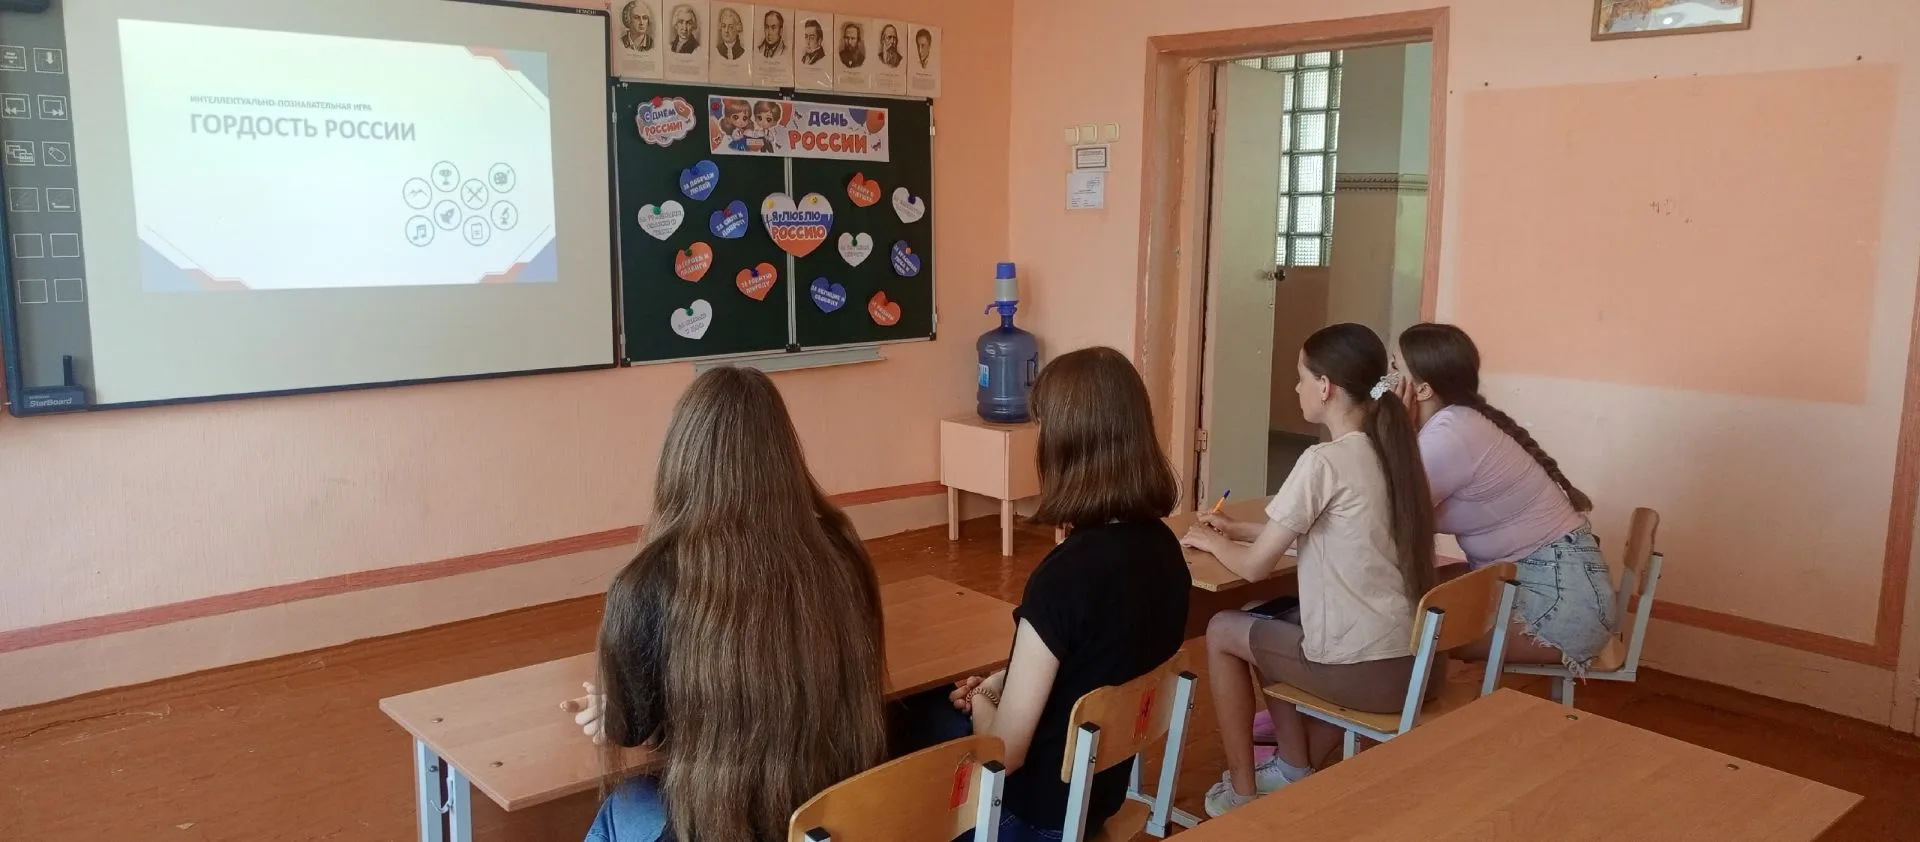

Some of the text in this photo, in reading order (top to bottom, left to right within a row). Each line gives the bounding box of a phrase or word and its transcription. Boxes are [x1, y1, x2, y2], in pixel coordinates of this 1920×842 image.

[190, 95, 372, 111] ИНТЕЛЛЕКТУАЛЬНО-ПОЗНАВАТЕЛЬНАЯ ИГРА
[644, 111, 651, 121] С
[190, 113, 416, 141] ГОРДОСТЬ РОССИИ
[644, 121, 683, 136] РОССИИ!
[788, 130, 868, 153] РОССИИ
[771, 211, 821, 222] Я ЛЮБЛЮ
[772, 226, 825, 239] РОССИЮ
[30, 398, 72, 407] StarBoard
